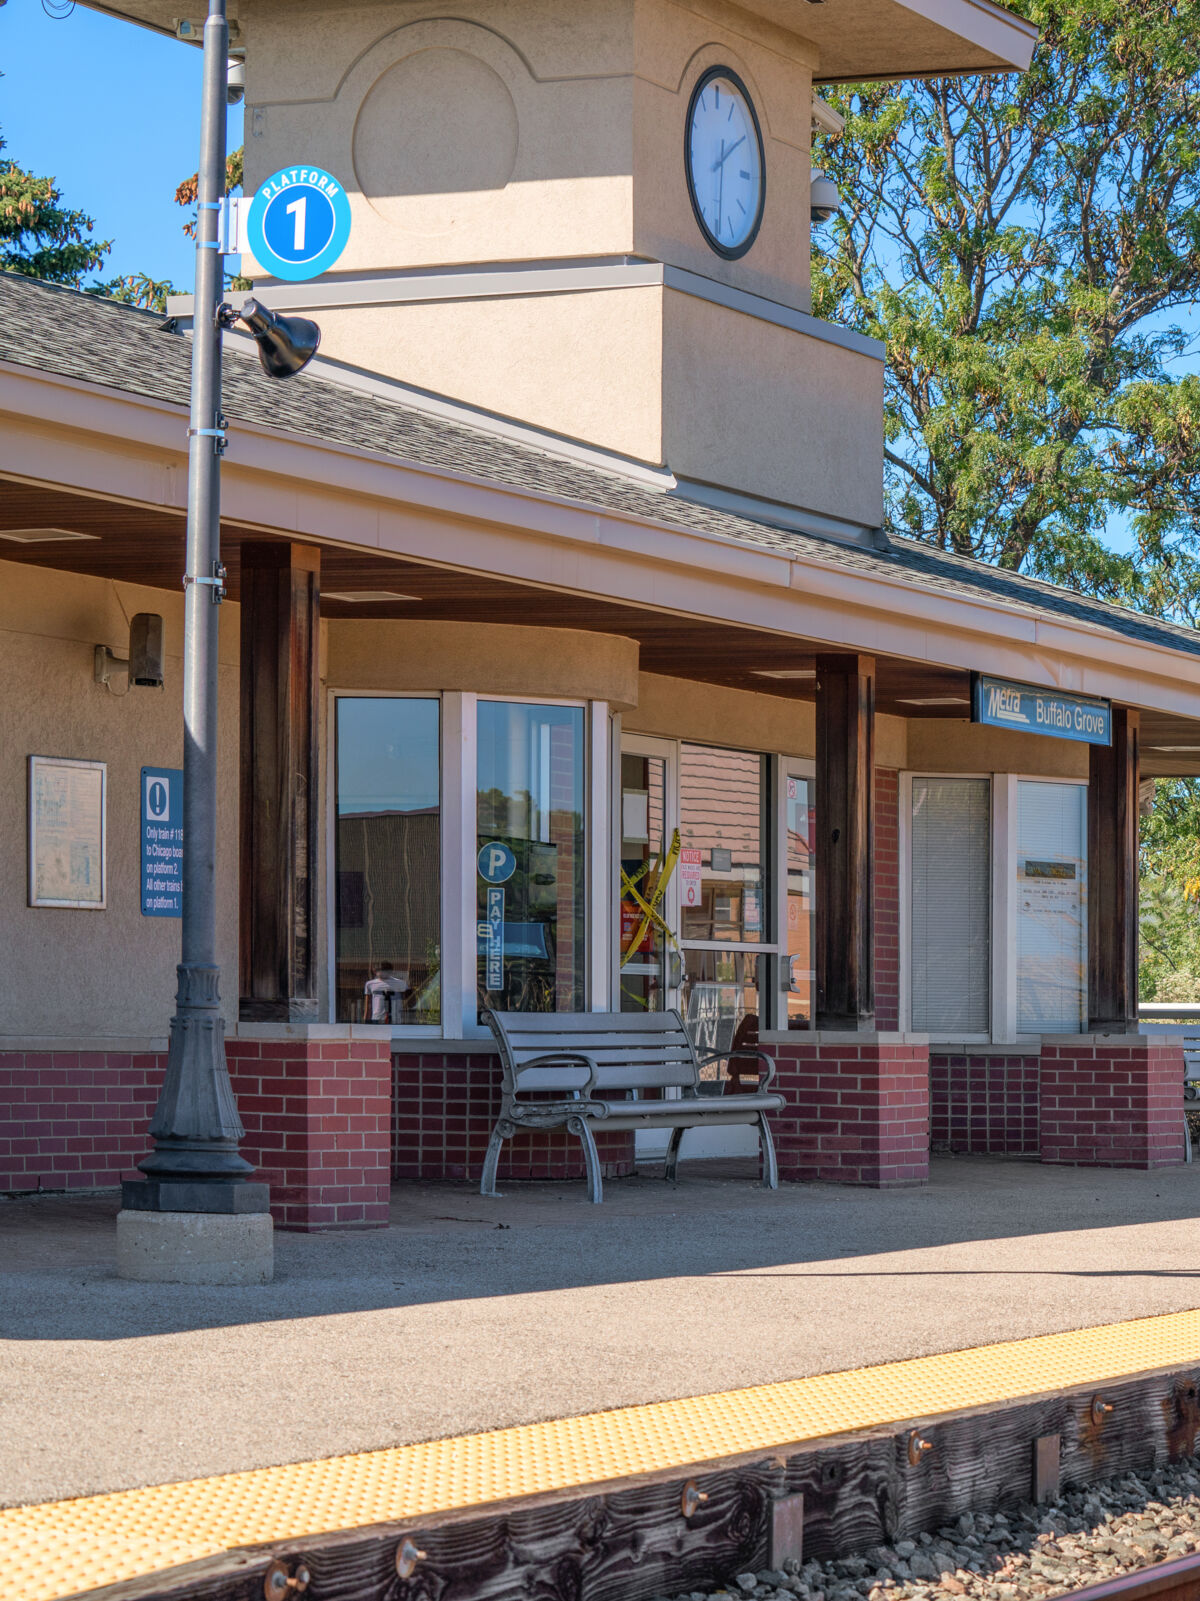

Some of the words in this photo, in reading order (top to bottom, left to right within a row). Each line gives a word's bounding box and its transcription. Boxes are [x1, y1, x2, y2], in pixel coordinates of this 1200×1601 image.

[262, 169, 339, 200] PLATFORM
[286, 197, 307, 250] 1
[988, 687, 1020, 718] Metra
[1036, 699, 1072, 728] Buffalo
[1074, 707, 1104, 734] Grove
[146, 826, 158, 842] Only
[158, 828, 169, 840] train
[170, 829, 174, 840] #
[146, 845, 152, 856] to
[152, 844, 172, 860] Chicago
[173, 846, 183, 858] boar
[489, 849, 506, 876] P
[682, 851, 699, 863] NOTICE
[146, 864, 153, 873] on
[154, 862, 173, 876] platform
[174, 864, 178, 875] 2.
[154, 879, 166, 891] other
[167, 880, 180, 892] trains
[146, 898, 153, 908] on
[154, 896, 173, 911] platform
[490, 892, 502, 930] PAY
[490, 936, 501, 986] HERE
